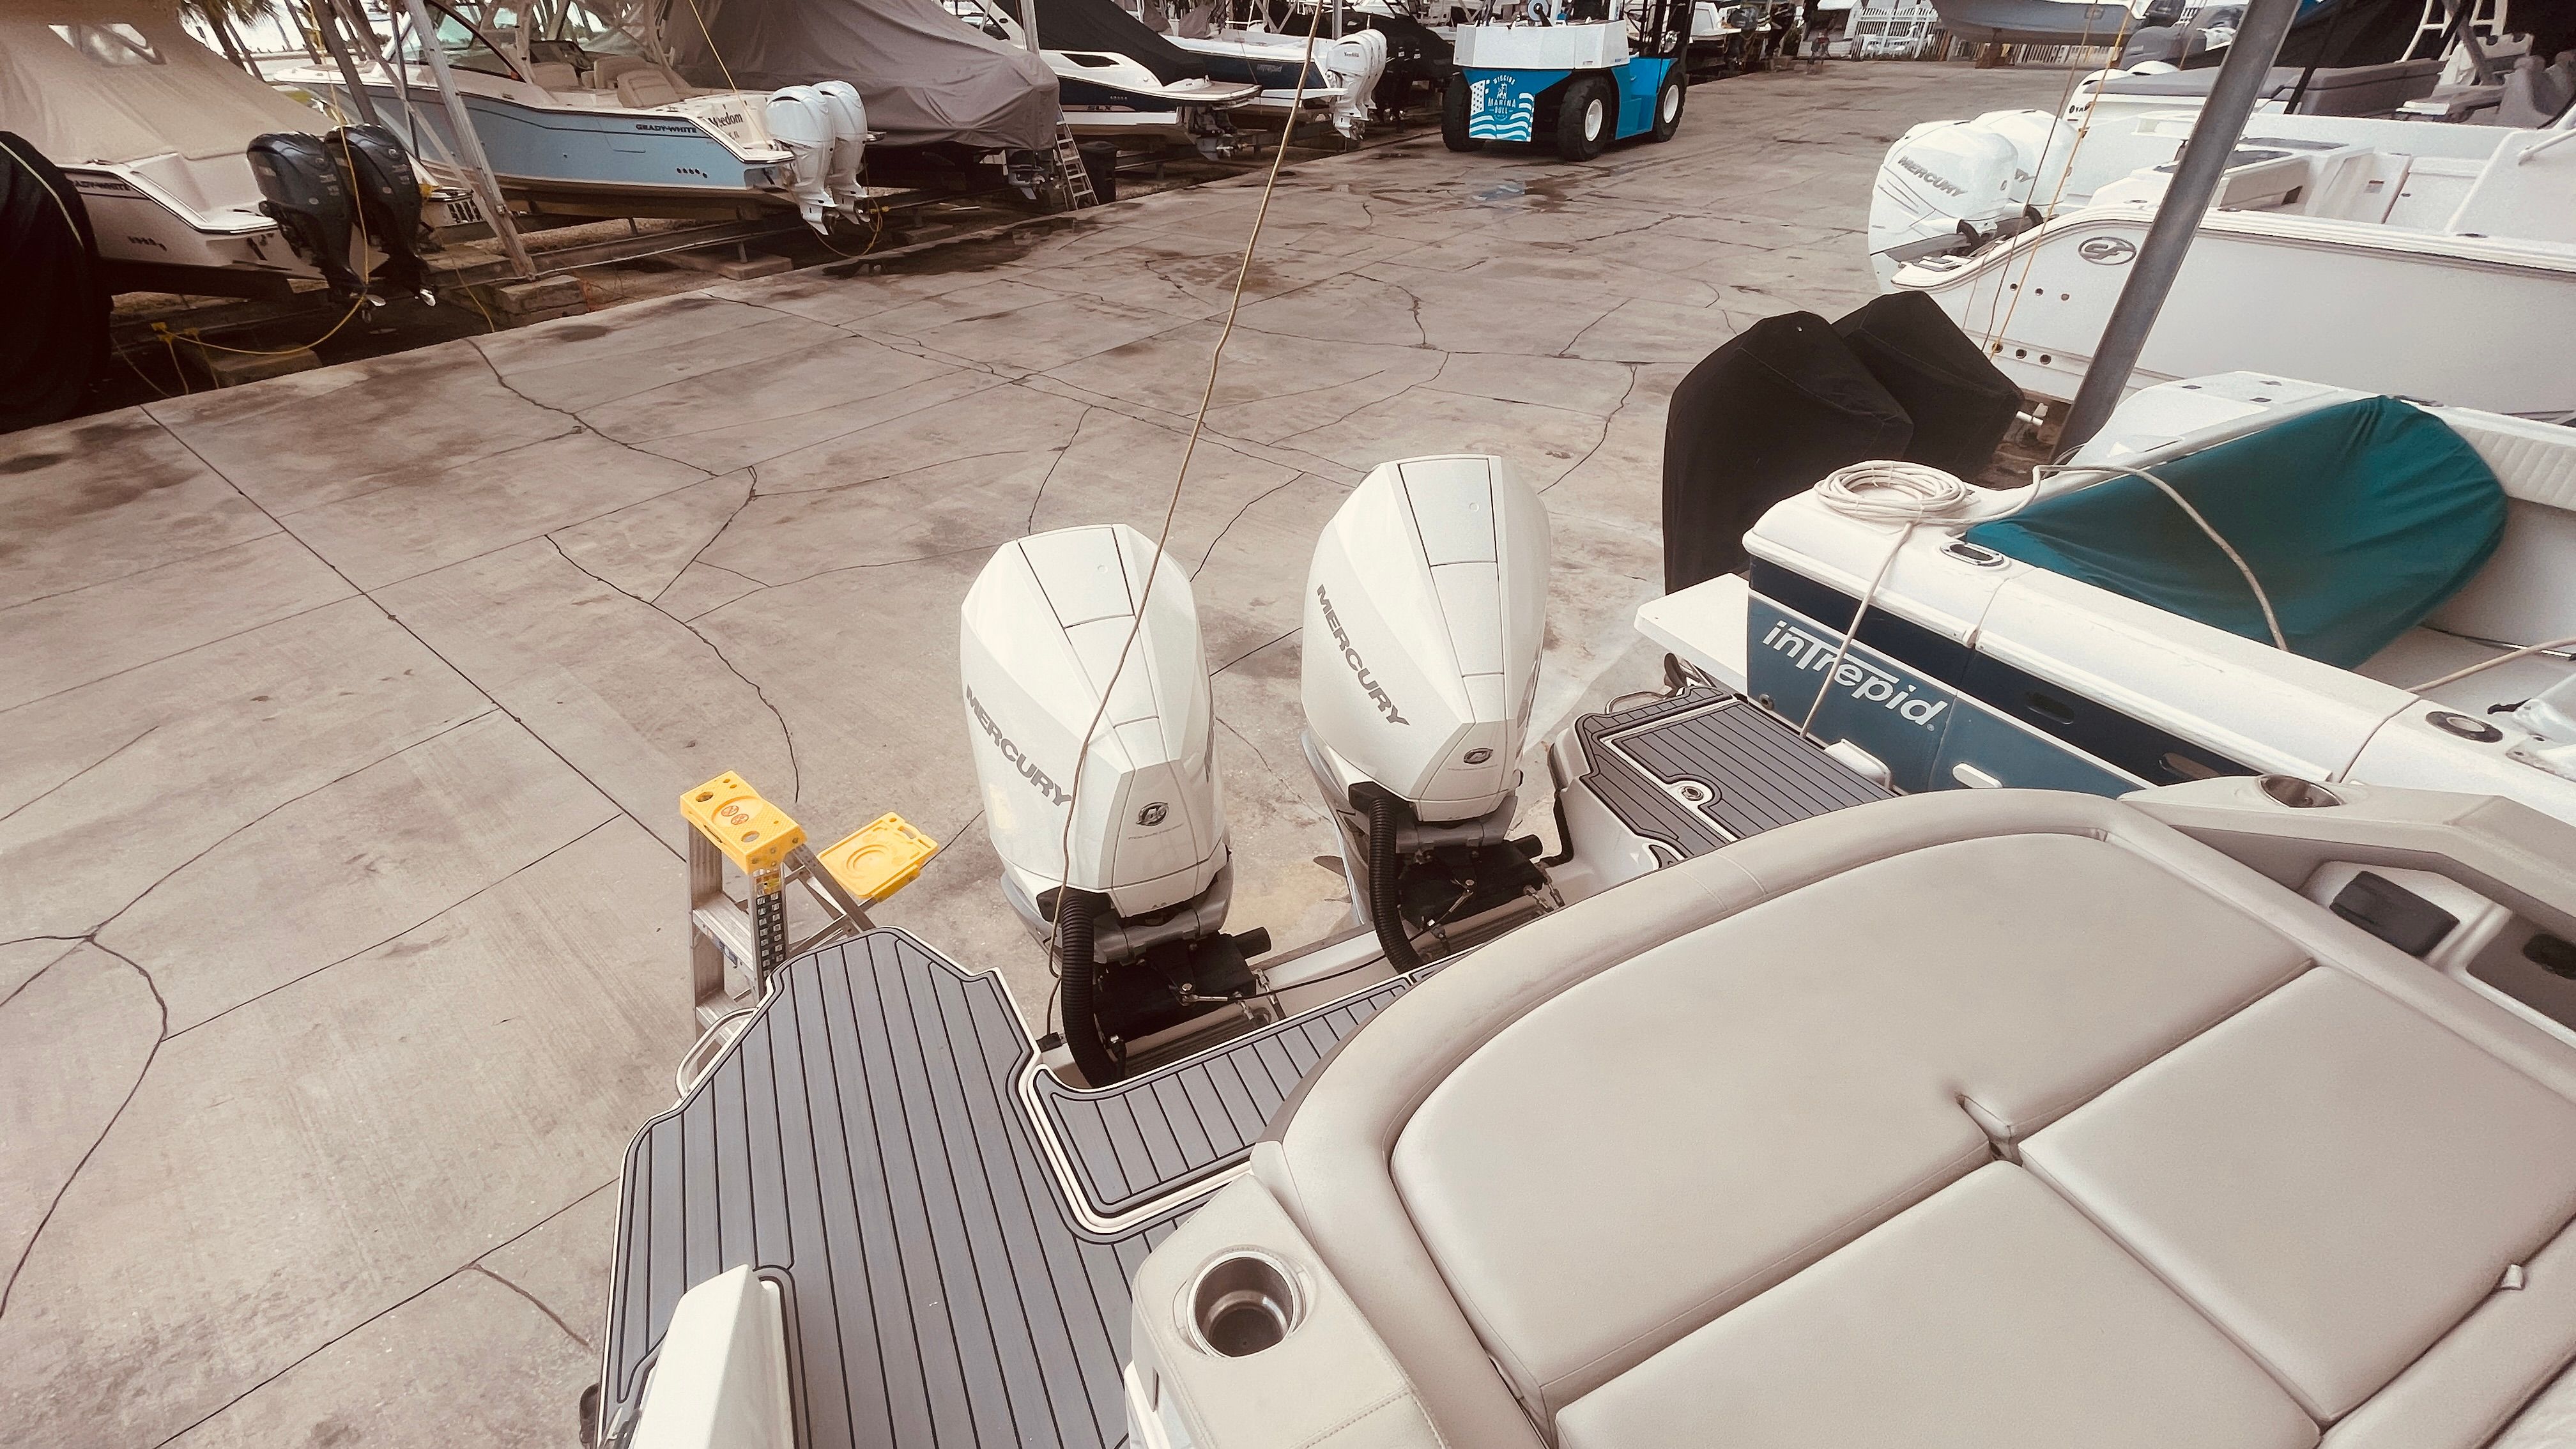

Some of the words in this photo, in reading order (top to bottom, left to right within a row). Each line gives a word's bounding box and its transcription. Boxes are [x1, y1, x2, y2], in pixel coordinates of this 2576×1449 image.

[1493, 75, 1515, 86] WIGGINS
[1487, 97, 1516, 108] MARINA
[1494, 106, 1508, 114] BULL
[635, 123, 698, 134] GRADY-WHITE
[1897, 155, 1968, 197] MERCURY
[1317, 584, 1411, 726] MERCURY
[966, 684, 1072, 807] MERCURY
